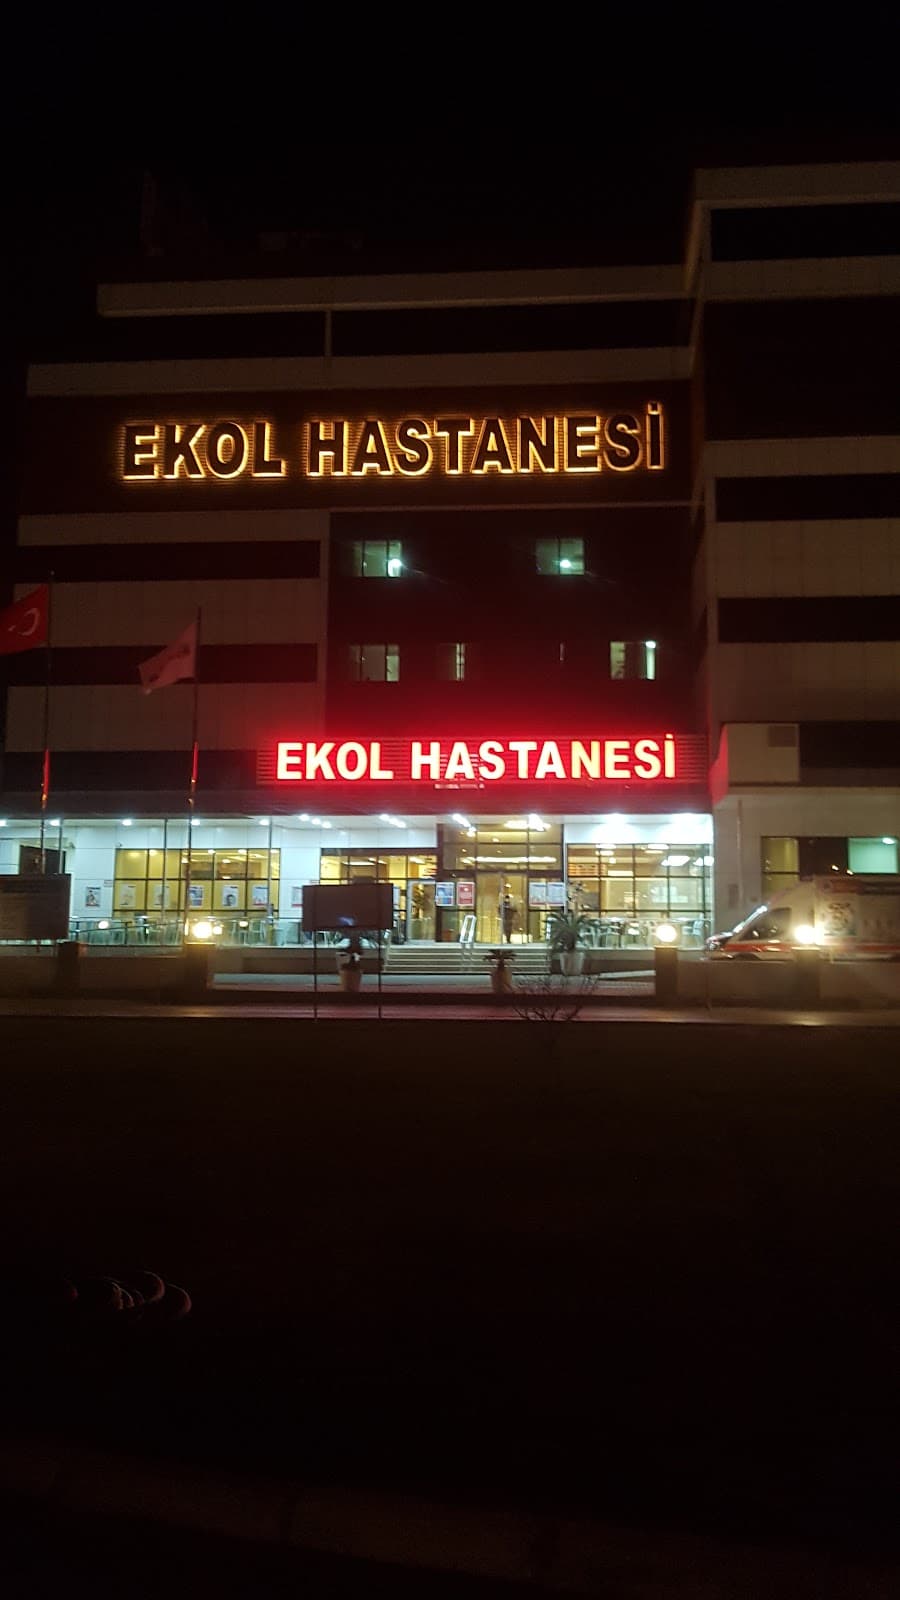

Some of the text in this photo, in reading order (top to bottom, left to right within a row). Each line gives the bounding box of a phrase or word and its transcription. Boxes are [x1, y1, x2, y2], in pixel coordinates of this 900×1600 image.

[122, 400, 665, 479] EKOL HASTANESİ
[277, 732, 676, 780] EKOL HASTANESİ
